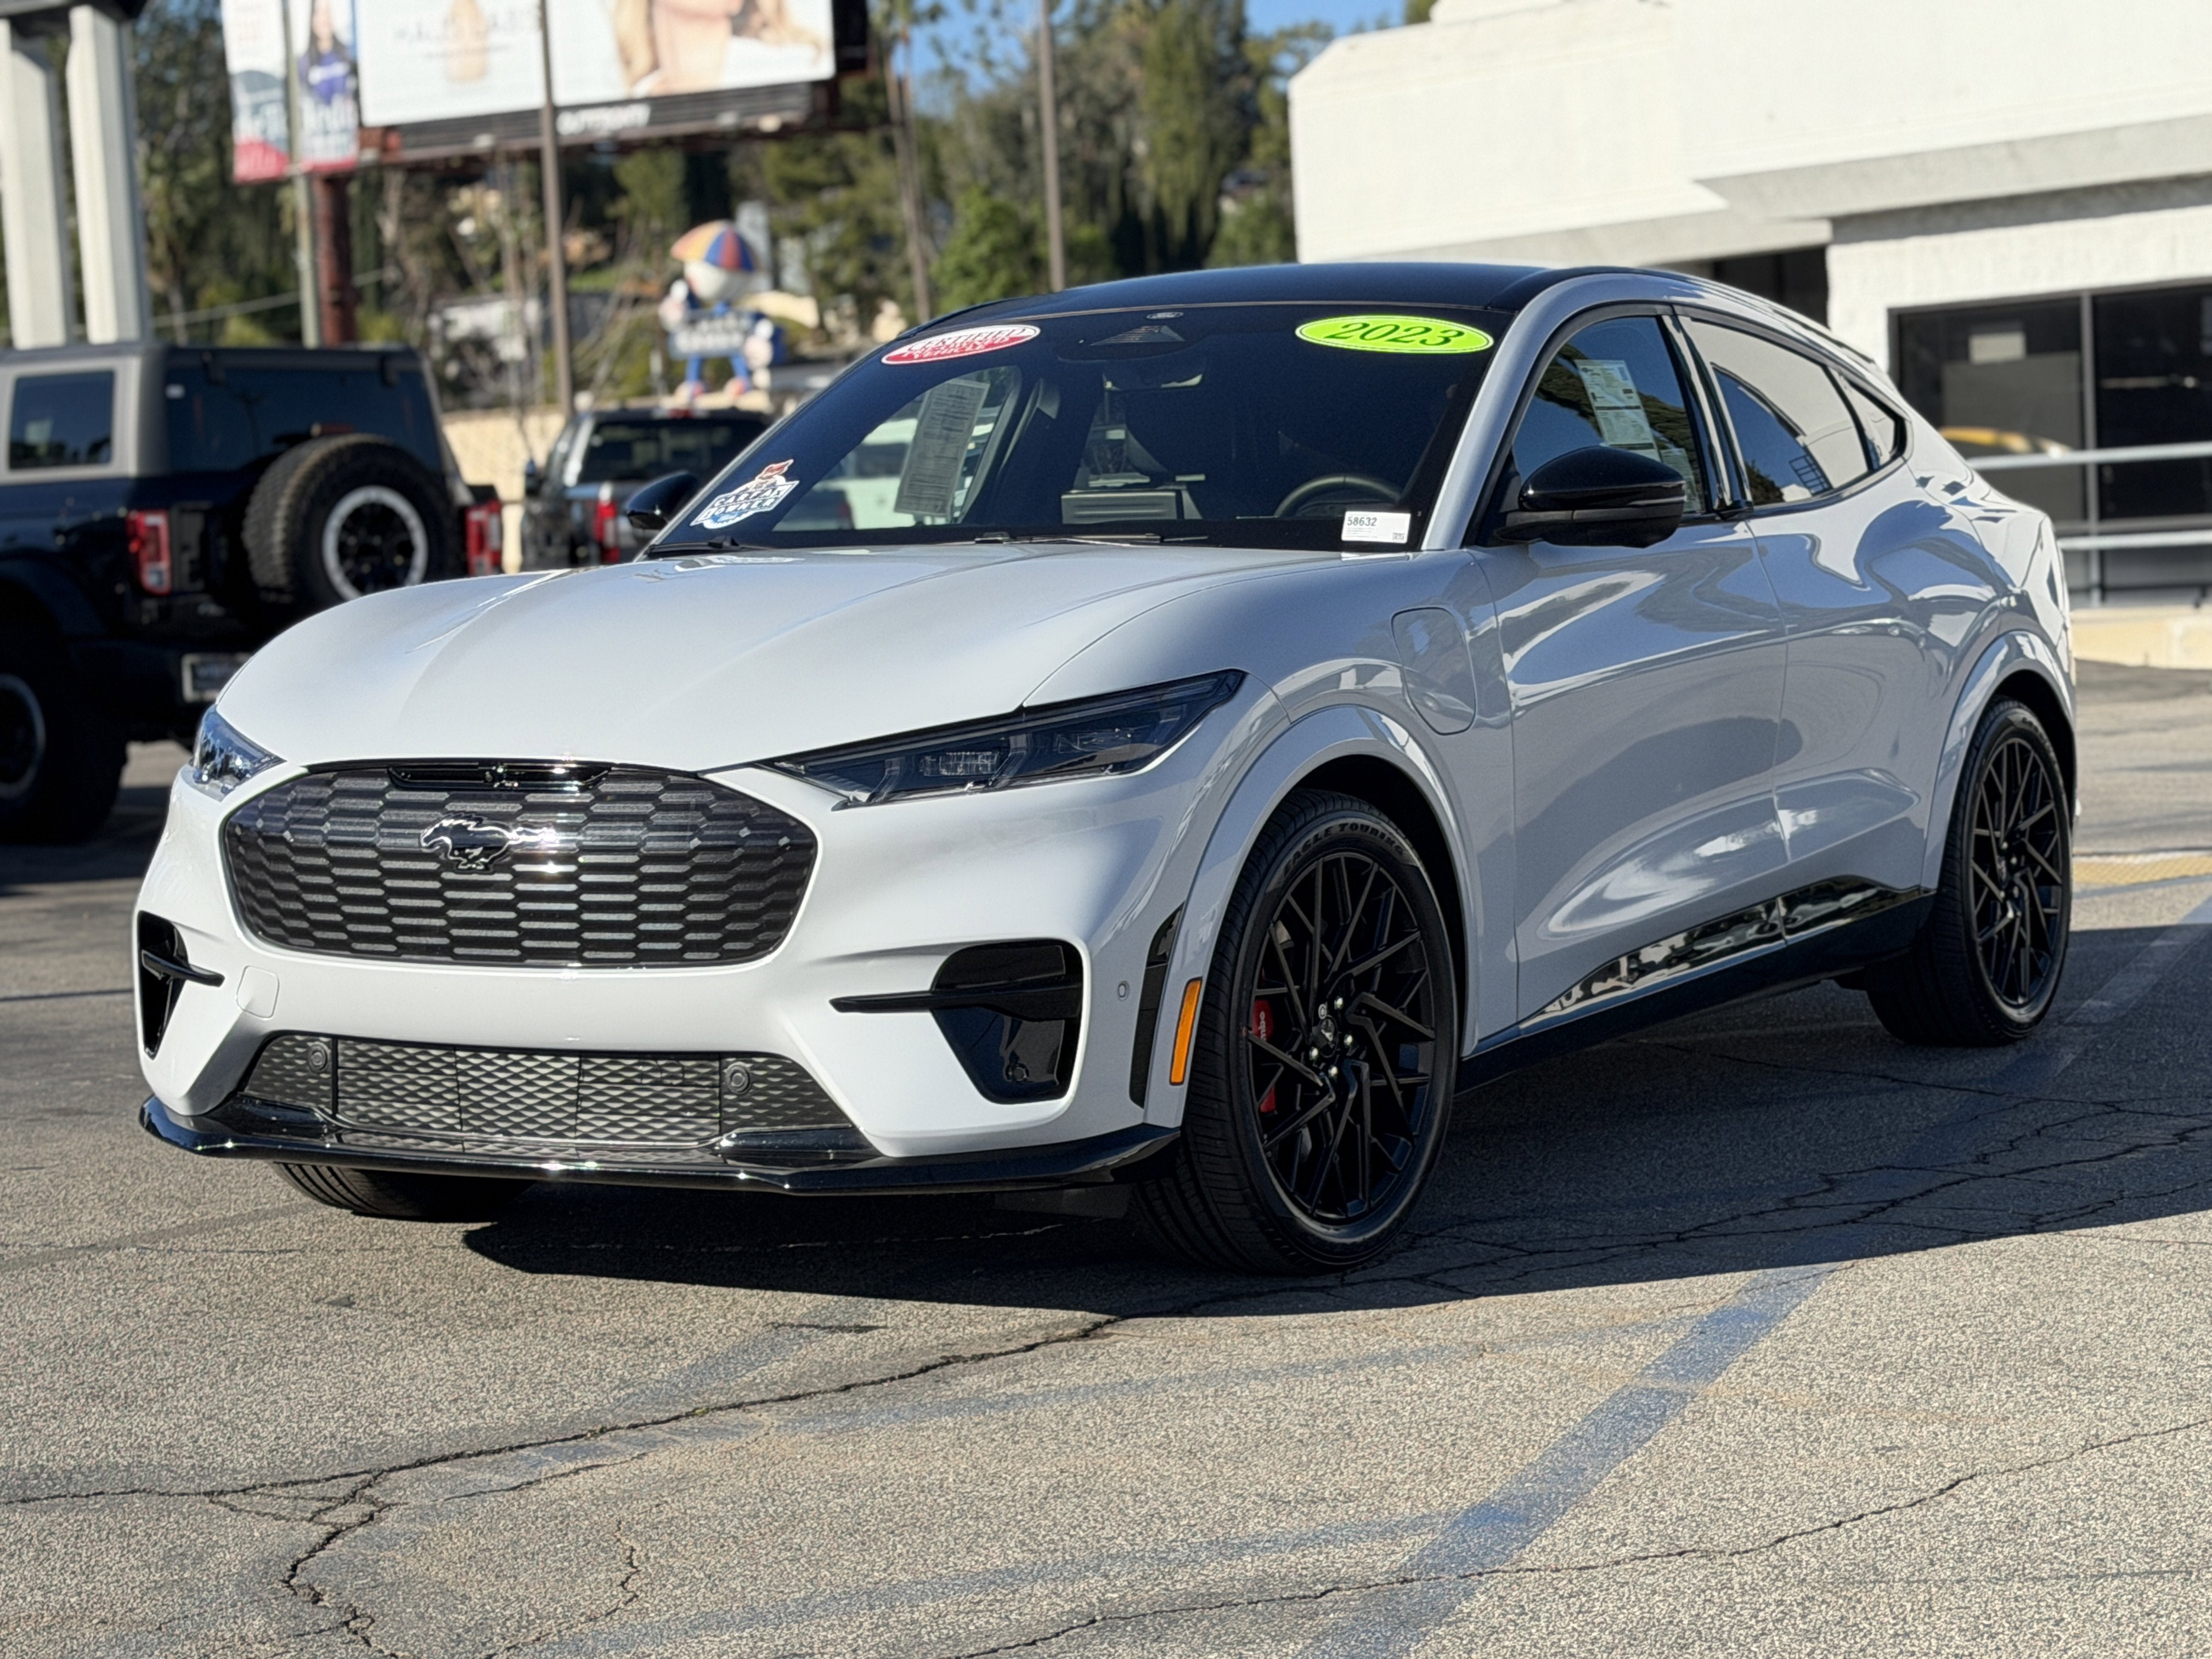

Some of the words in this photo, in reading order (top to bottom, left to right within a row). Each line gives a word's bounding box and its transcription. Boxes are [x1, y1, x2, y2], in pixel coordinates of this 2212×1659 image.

[908, 328, 1025, 352] CERTIFIED
[1324, 322, 1465, 346] 2023
[714, 485, 792, 507] CARFAX
[715, 498, 775, 516] OWNER
[1347, 516, 1378, 526] 58632
[1284, 826, 1333, 877] EAGLE
[1339, 822, 1404, 855] TOURING
